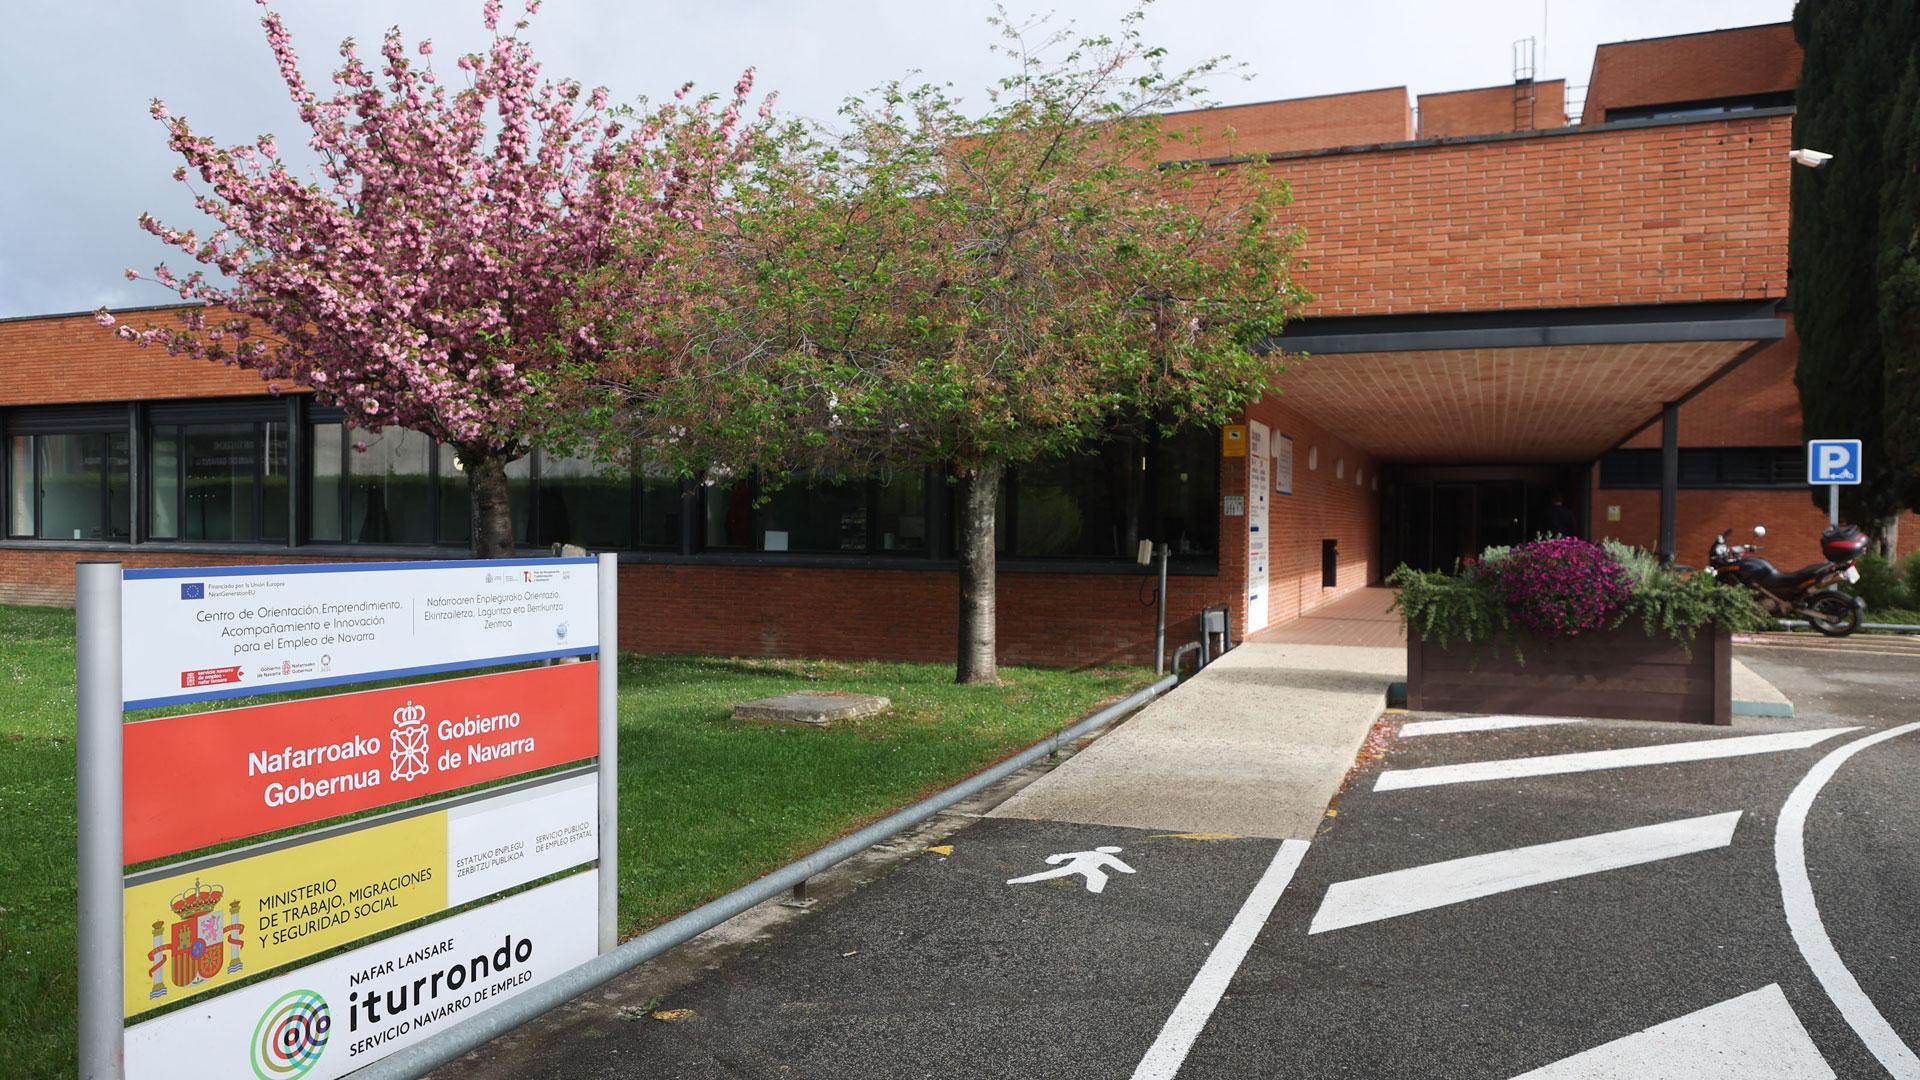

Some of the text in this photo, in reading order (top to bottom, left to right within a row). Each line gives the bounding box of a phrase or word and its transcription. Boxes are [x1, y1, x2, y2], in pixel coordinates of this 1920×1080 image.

[1819, 445, 1850, 479] P
[208, 589, 256, 598] NextGenerationEU
[427, 596, 475, 607] Nafarroaren
[476, 593, 522, 605] Enplegurako
[196, 610, 235, 623] Centro
[238, 609, 254, 620] de
[477, 606, 512, 619] Laguntza
[513, 605, 526, 614] eta
[527, 602, 564, 613] Berrikuntza
[221, 616, 385, 637] Acompañamiento e Innovación
[233, 632, 375, 656] para el Empleo de Navarra
[437, 712, 520, 741] Gobierno
[248, 735, 381, 776] Nafarroako
[437, 737, 535, 771] de Navarra
[264, 768, 381, 808] Gobernua
[535, 829, 563, 844] SERVICIO
[535, 829, 593, 853] DE EMPLEO ESTATAL
[456, 841, 524, 868] ESTATUKO ENPLEGU
[457, 851, 525, 878] ZERBITZU PUBLIKOA
[259, 878, 337, 912] MINISTERIO
[259, 911, 279, 930] DE
[282, 895, 346, 922] TRABAJO,
[349, 867, 432, 903] MIGRACIONES
[259, 935, 268, 949] Y
[272, 910, 351, 945] SEGURIDAD
[354, 895, 399, 919] SOCIAL
[349, 938, 455, 987] NAFAR LANSARE
[349, 934, 533, 1033] iturrondo
[349, 969, 532, 1057] SERVICIO NAVARRO DE EMPLEO
